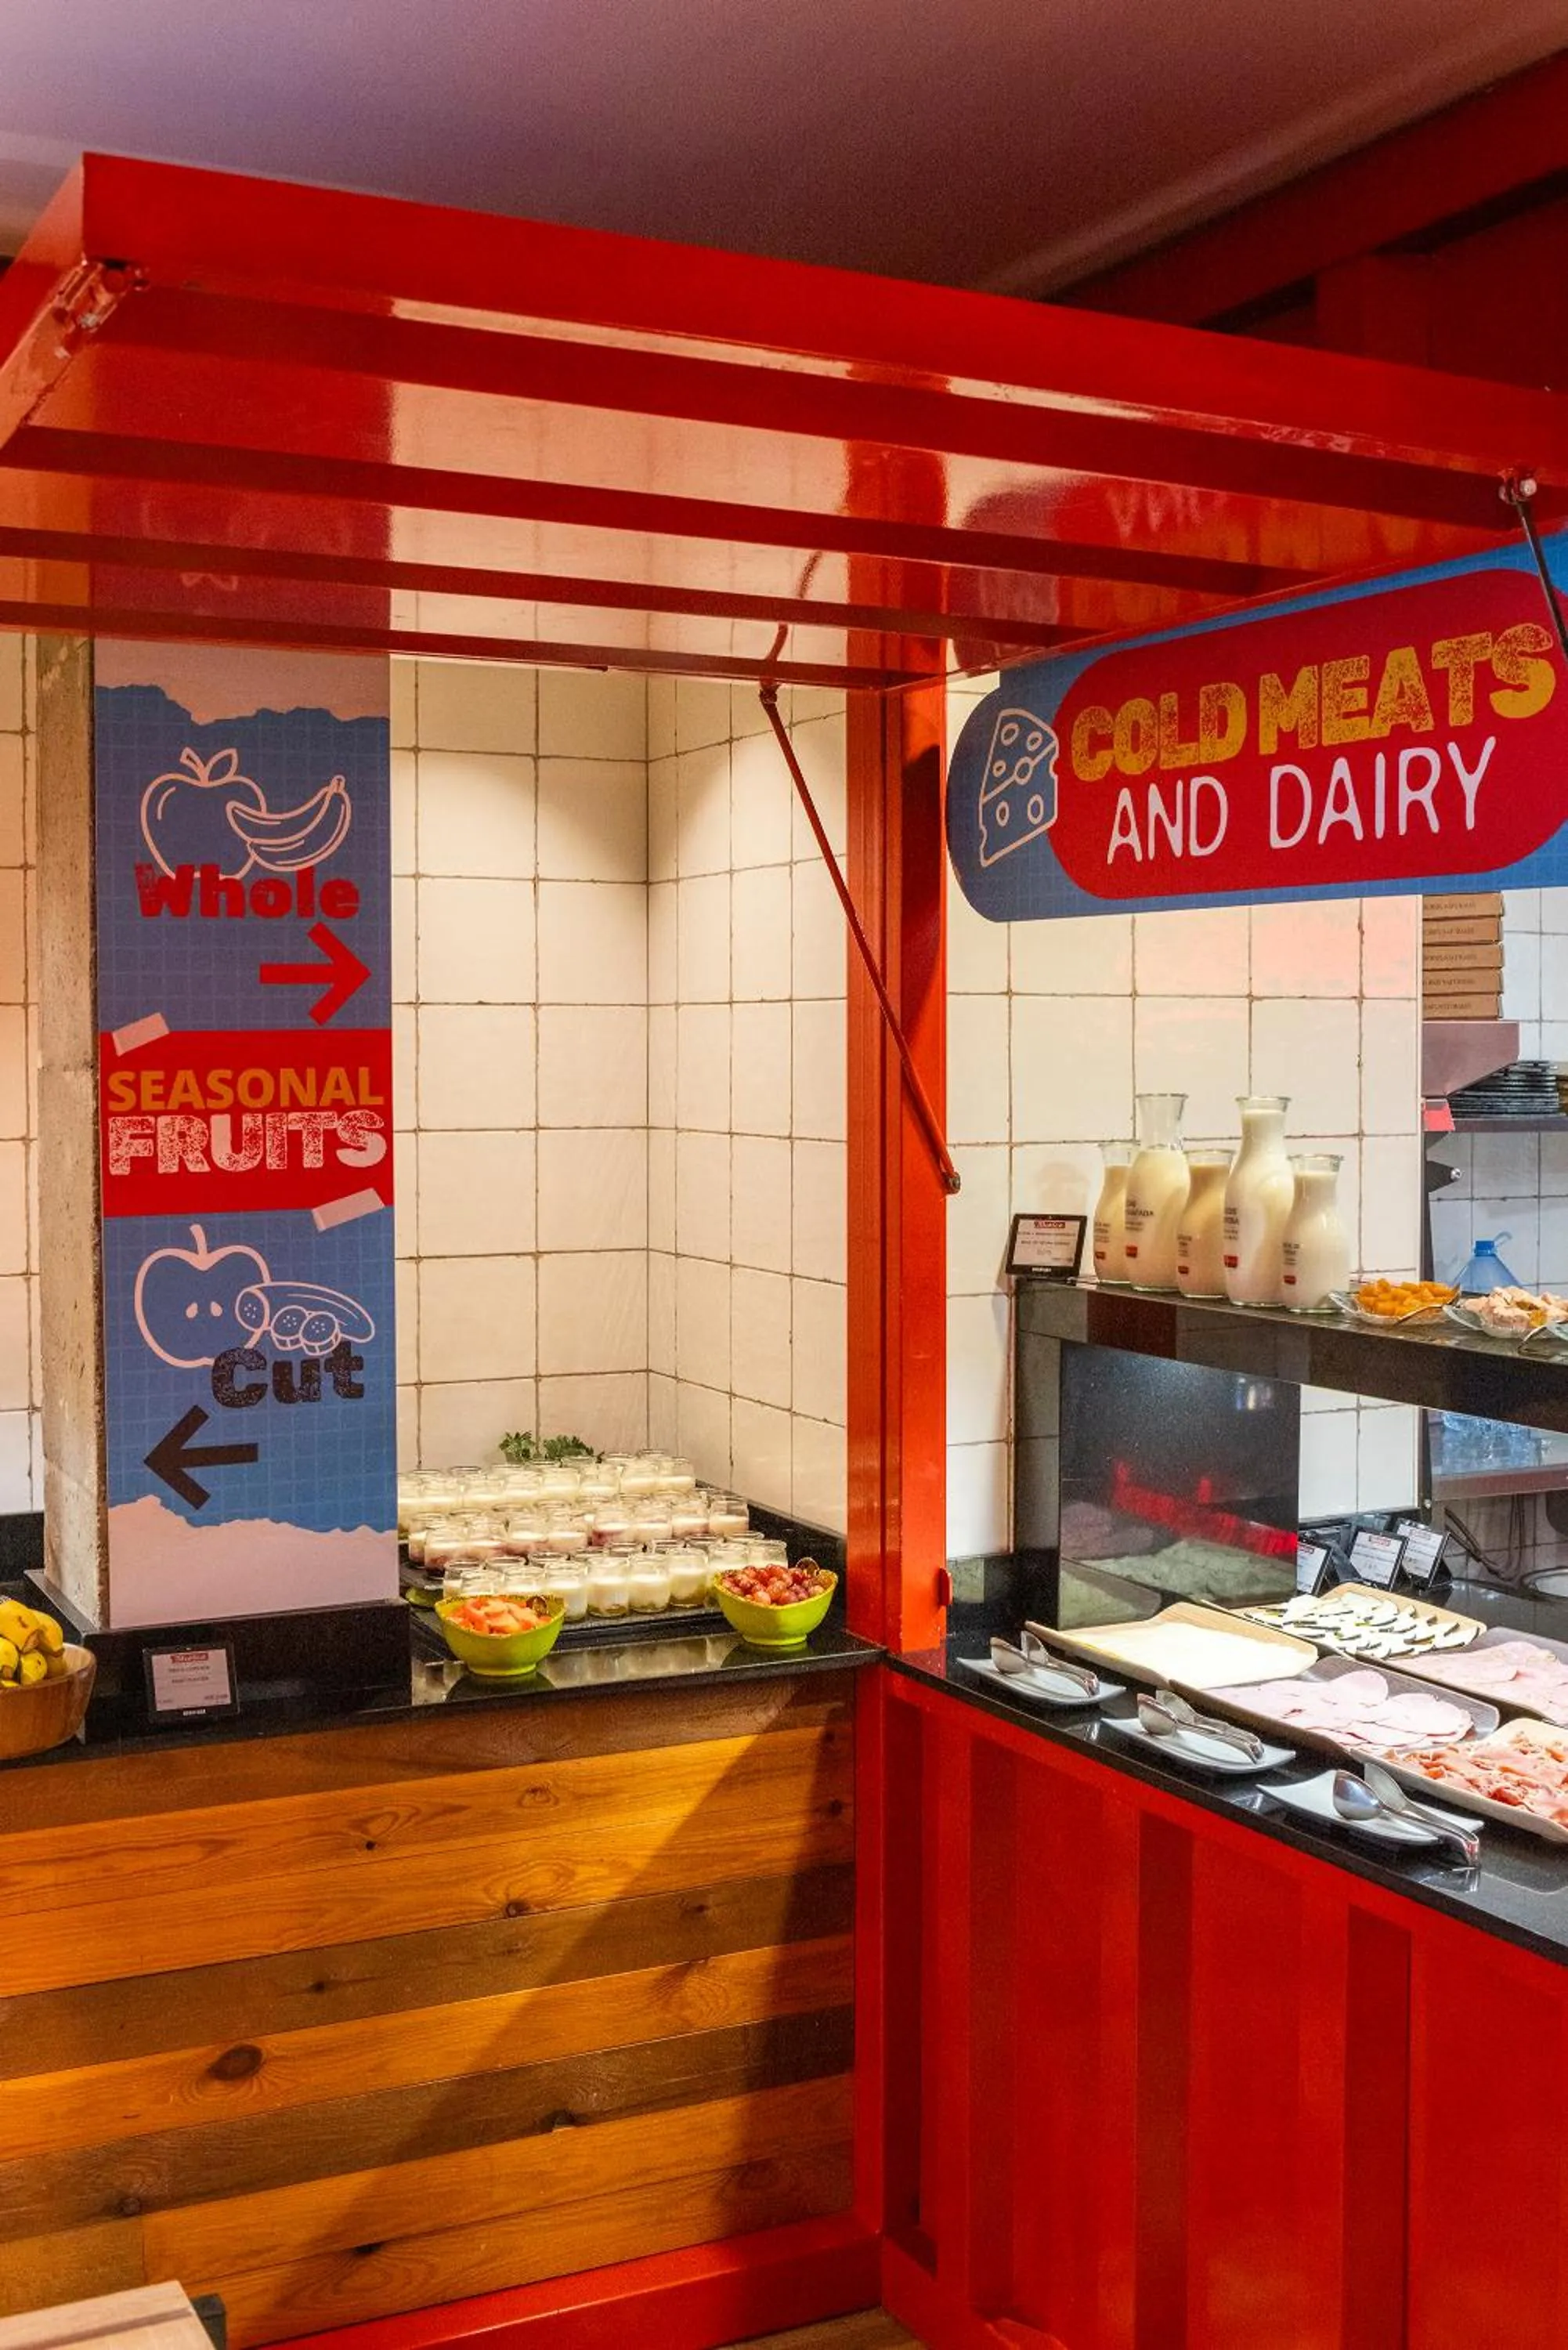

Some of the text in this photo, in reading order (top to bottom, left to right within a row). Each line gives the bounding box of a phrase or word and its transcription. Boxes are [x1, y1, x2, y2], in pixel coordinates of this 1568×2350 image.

[1071, 623, 1556, 781] COLD MEATS
[1107, 736, 1496, 865] AND DAIRY
[135, 863, 359, 919] Whole
[108, 1066, 385, 1112] SEASONAL
[108, 1109, 387, 1175] FRUITS
[211, 1340, 364, 1408] Cut
